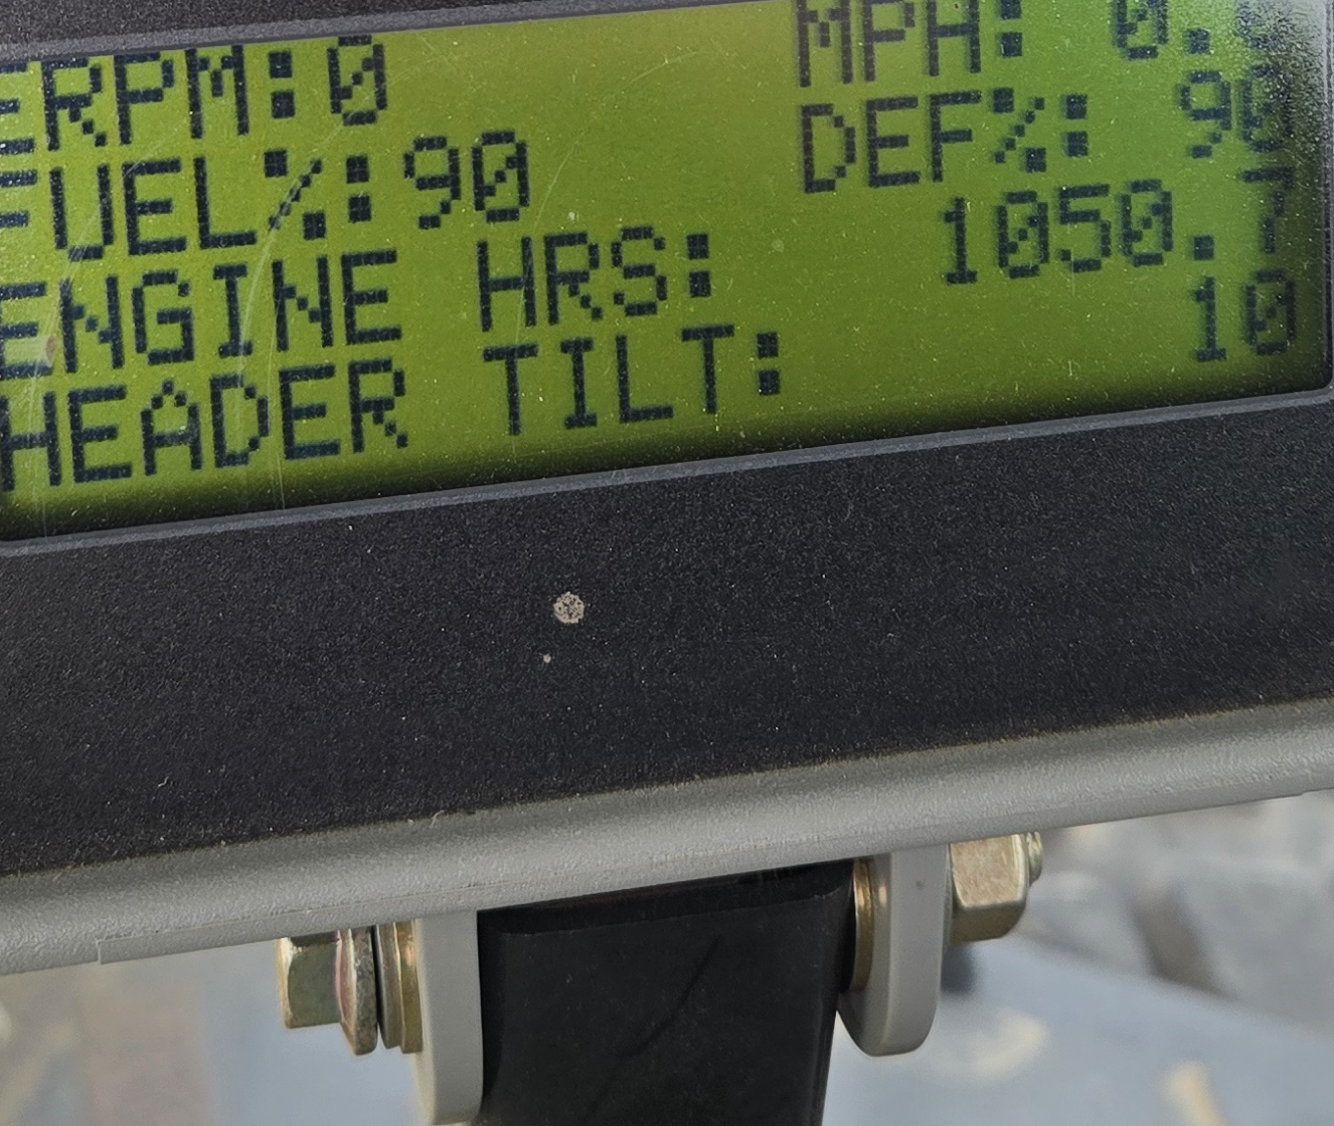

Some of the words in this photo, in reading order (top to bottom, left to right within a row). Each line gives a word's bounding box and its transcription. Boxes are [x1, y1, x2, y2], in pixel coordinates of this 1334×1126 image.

[800, 88, 1088, 194] DEF%:
[1177, 64, 1294, 159] 90
[476, 226, 712, 331] HRS:
[943, 167, 1295, 284] 1050.7
[483, 324, 781, 435] TILT:
[1192, 269, 1297, 363] 10
